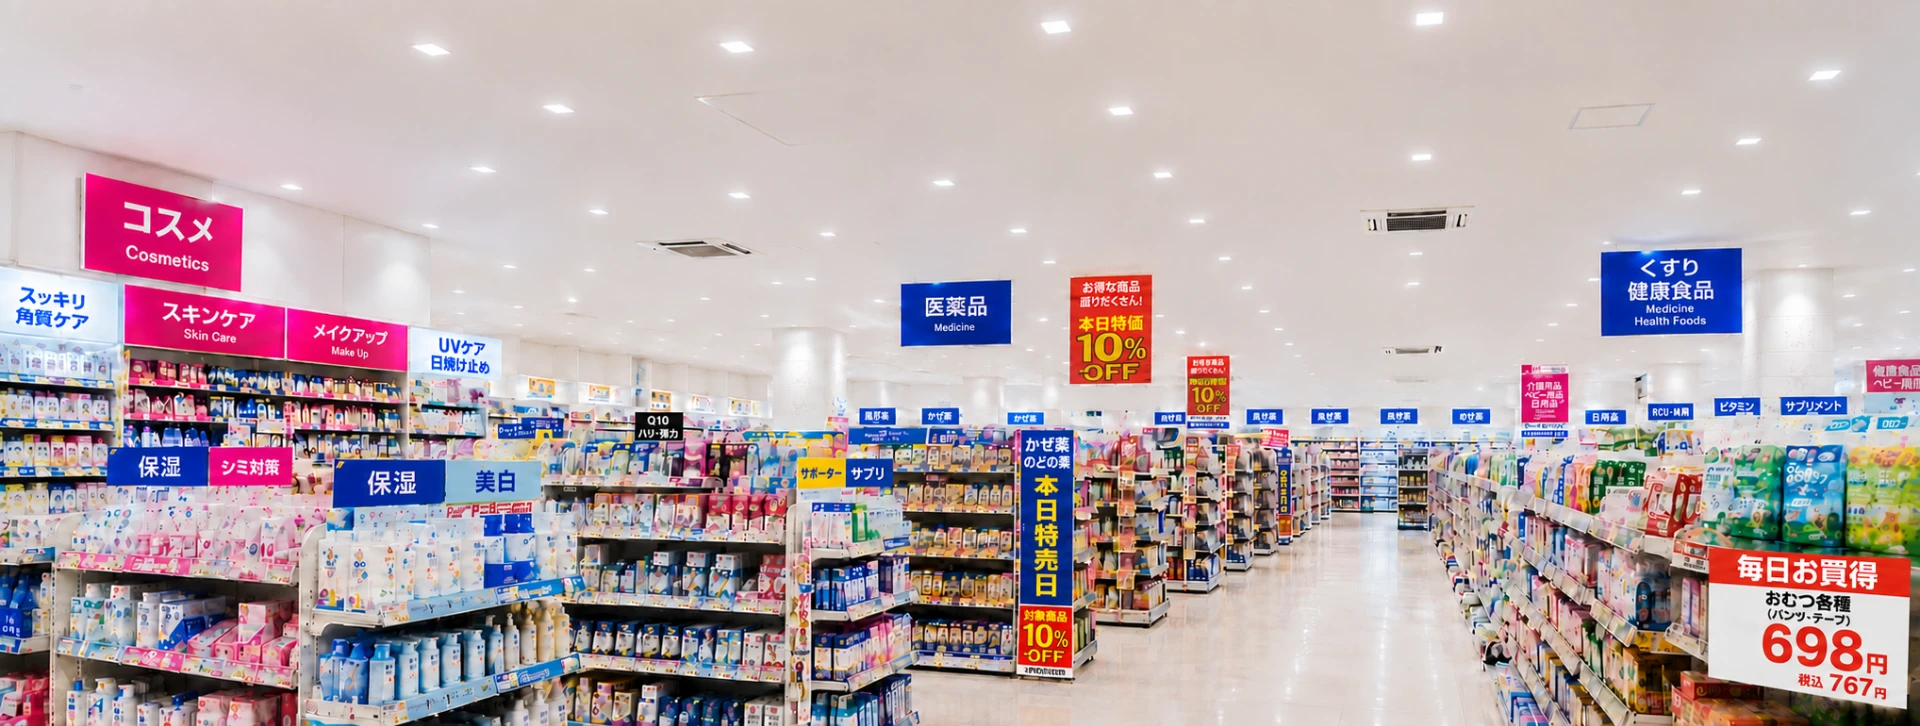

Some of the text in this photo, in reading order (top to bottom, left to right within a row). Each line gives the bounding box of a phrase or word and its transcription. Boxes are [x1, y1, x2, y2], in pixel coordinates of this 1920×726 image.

[123, 201, 213, 243] コスメ
[125, 245, 209, 272] Cosmetics
[1640, 258, 1699, 277] くすり
[1082, 280, 1140, 294] お得な商品
[1628, 280, 1714, 301] 健康食品
[19, 286, 85, 310] スッキリ
[925, 296, 987, 317] 医薬品
[162, 302, 256, 330] スキンケア
[1646, 303, 1694, 314] Medicine
[16, 307, 89, 330] 角質ケア
[934, 322, 975, 332] Medicine
[1078, 315, 1143, 332] 本日特価
[1635, 316, 1706, 326] Health Foods
[183, 329, 236, 344] Skin Care
[313, 323, 388, 345] メイクアップ
[331, 346, 369, 360] Make Up
[439, 337, 486, 356] UVケア
[1076, 331, 1147, 363] 10%
[431, 354, 490, 375] 日焼け止め
[1192, 387, 1226, 404] 10%
[1785, 400, 1842, 413] サプリメント
[647, 415, 670, 427] Q10
[1024, 436, 1070, 453] かぜ薬
[138, 455, 182, 479] 保湿
[221, 459, 280, 476] シミ対策
[1023, 455, 1071, 470] のどの薬
[367, 469, 417, 496] 保湿
[475, 469, 516, 494] 美白
[801, 467, 842, 480] サポーター
[850, 467, 885, 481] サプリ
[1034, 474, 1059, 598] 本日特売日
[1737, 553, 1879, 591] 毎日お買得
[1765, 589, 1851, 614] おむつ各種
[1023, 623, 1069, 648] 10%
[1797, 673, 1824, 690] 税込
